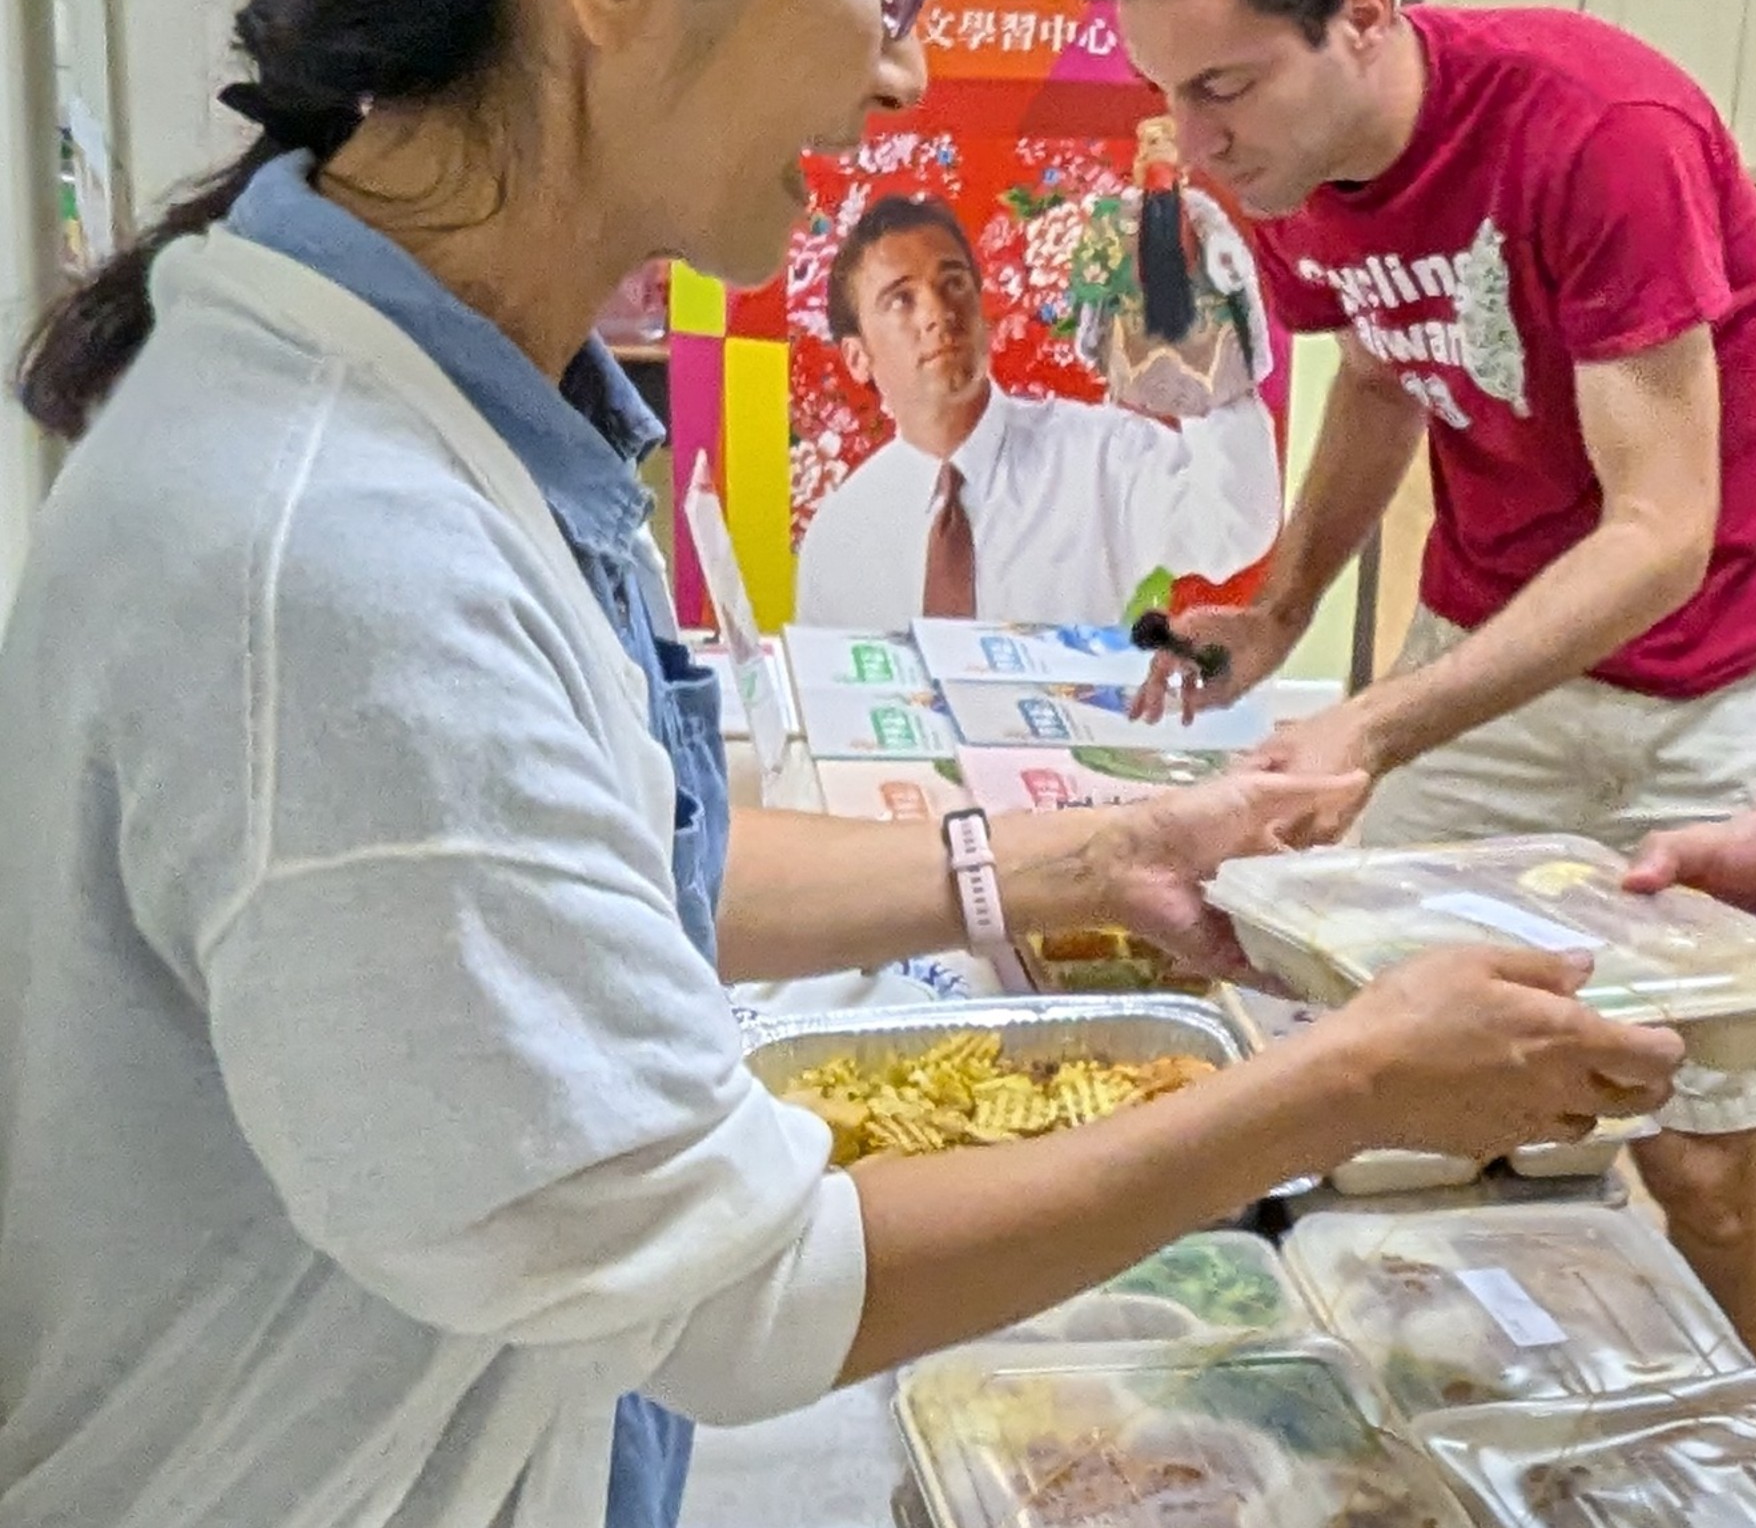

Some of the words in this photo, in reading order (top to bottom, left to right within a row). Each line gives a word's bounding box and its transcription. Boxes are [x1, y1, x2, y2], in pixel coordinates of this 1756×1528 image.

[922, 5, 1119, 57] 文學習中心
